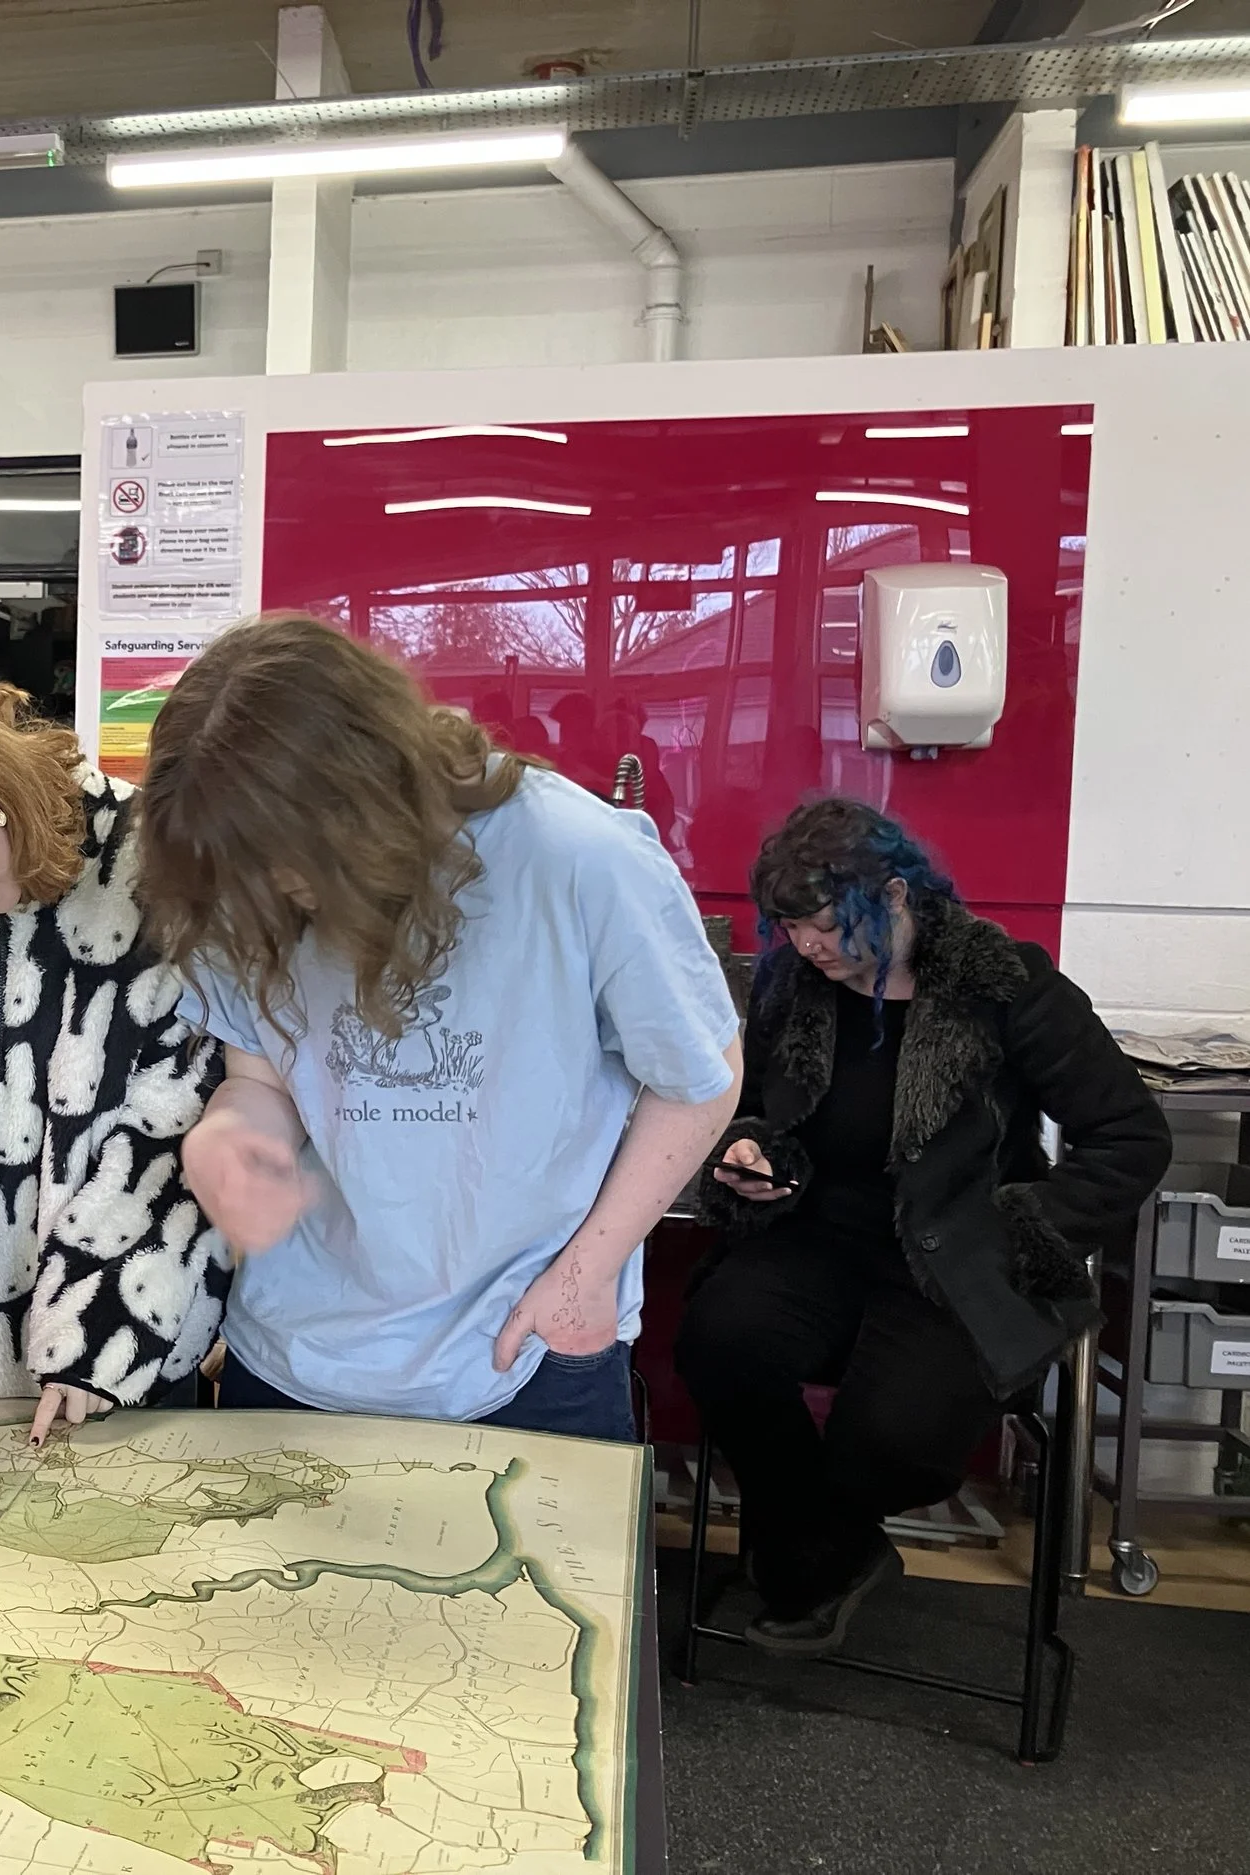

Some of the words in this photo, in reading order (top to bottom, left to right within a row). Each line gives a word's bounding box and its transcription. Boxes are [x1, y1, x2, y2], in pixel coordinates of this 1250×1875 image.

[105, 640, 174, 653] Safeguarding
[178, 641, 209, 651] Servi
[343, 1100, 382, 1122] role
[392, 1100, 463, 1123] model
[536, 1475, 564, 1534] SEA
[556, 1547, 597, 1584] THE
